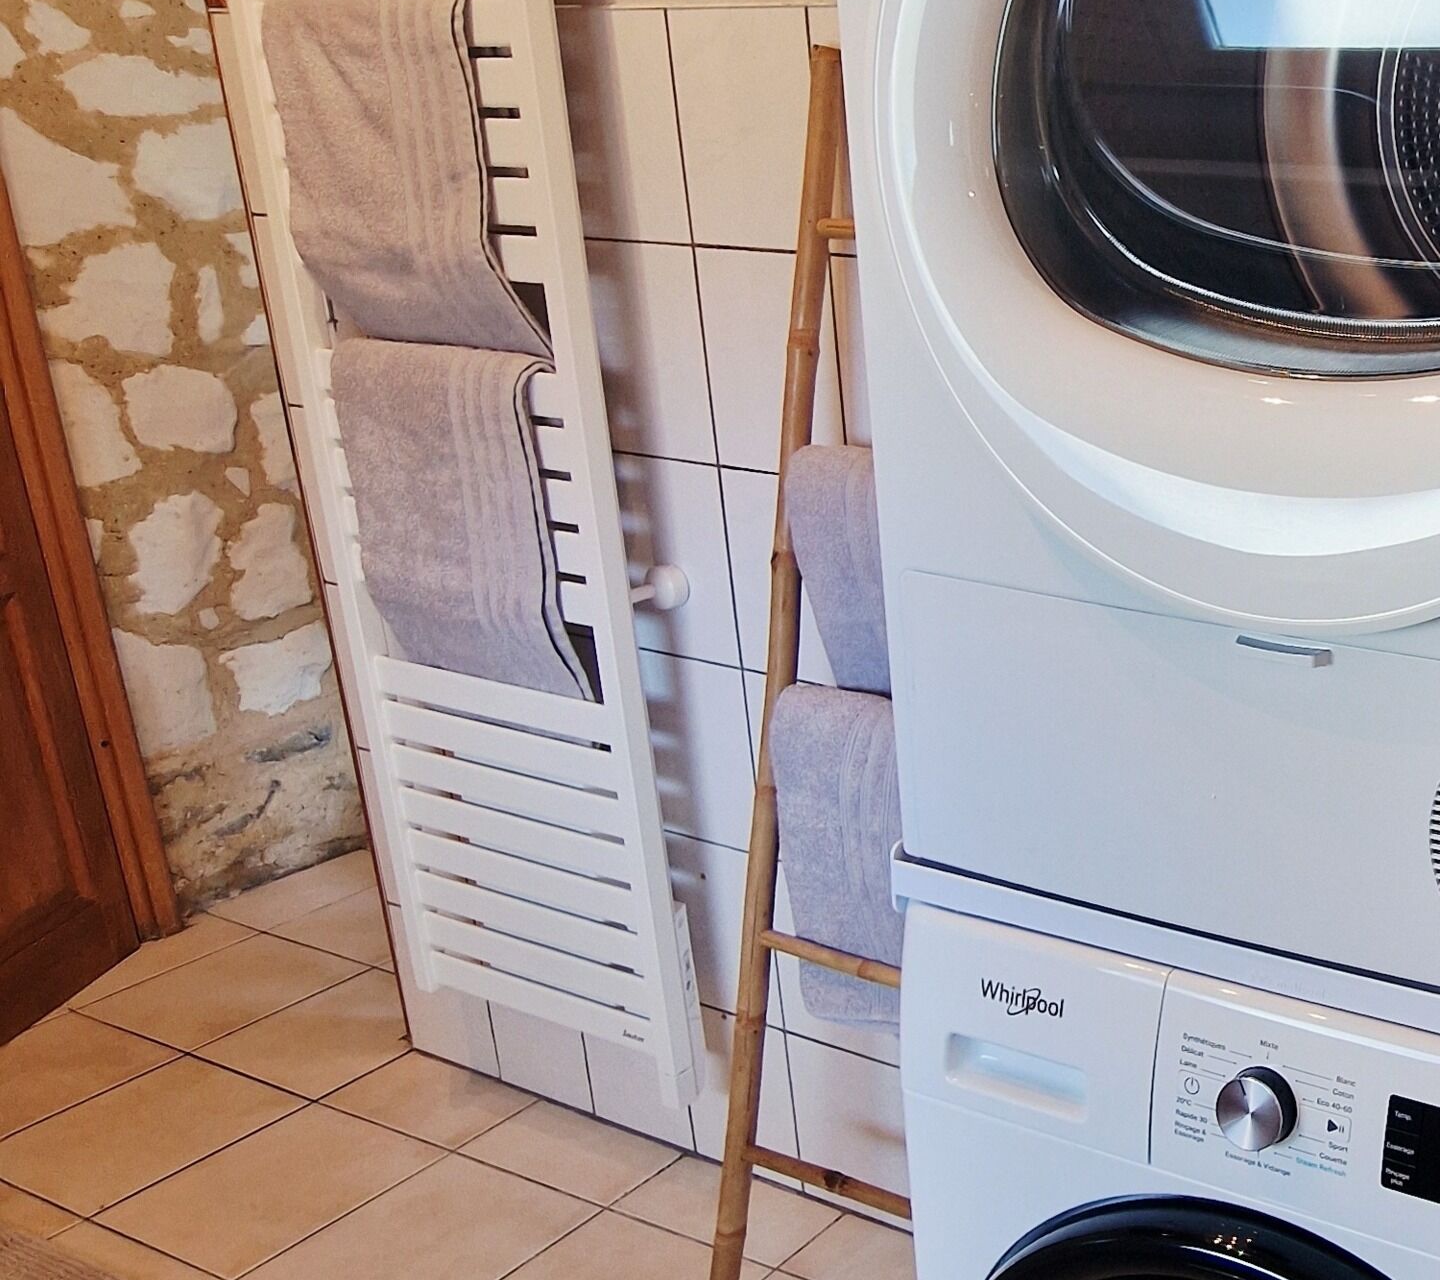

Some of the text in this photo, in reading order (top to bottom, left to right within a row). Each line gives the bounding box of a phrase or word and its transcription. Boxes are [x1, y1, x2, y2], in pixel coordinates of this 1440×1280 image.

[981, 977, 1064, 1018] Whirlpool
[1332, 1087, 1354, 1100] Coton
[1316, 1097, 1330, 1107] Eco
